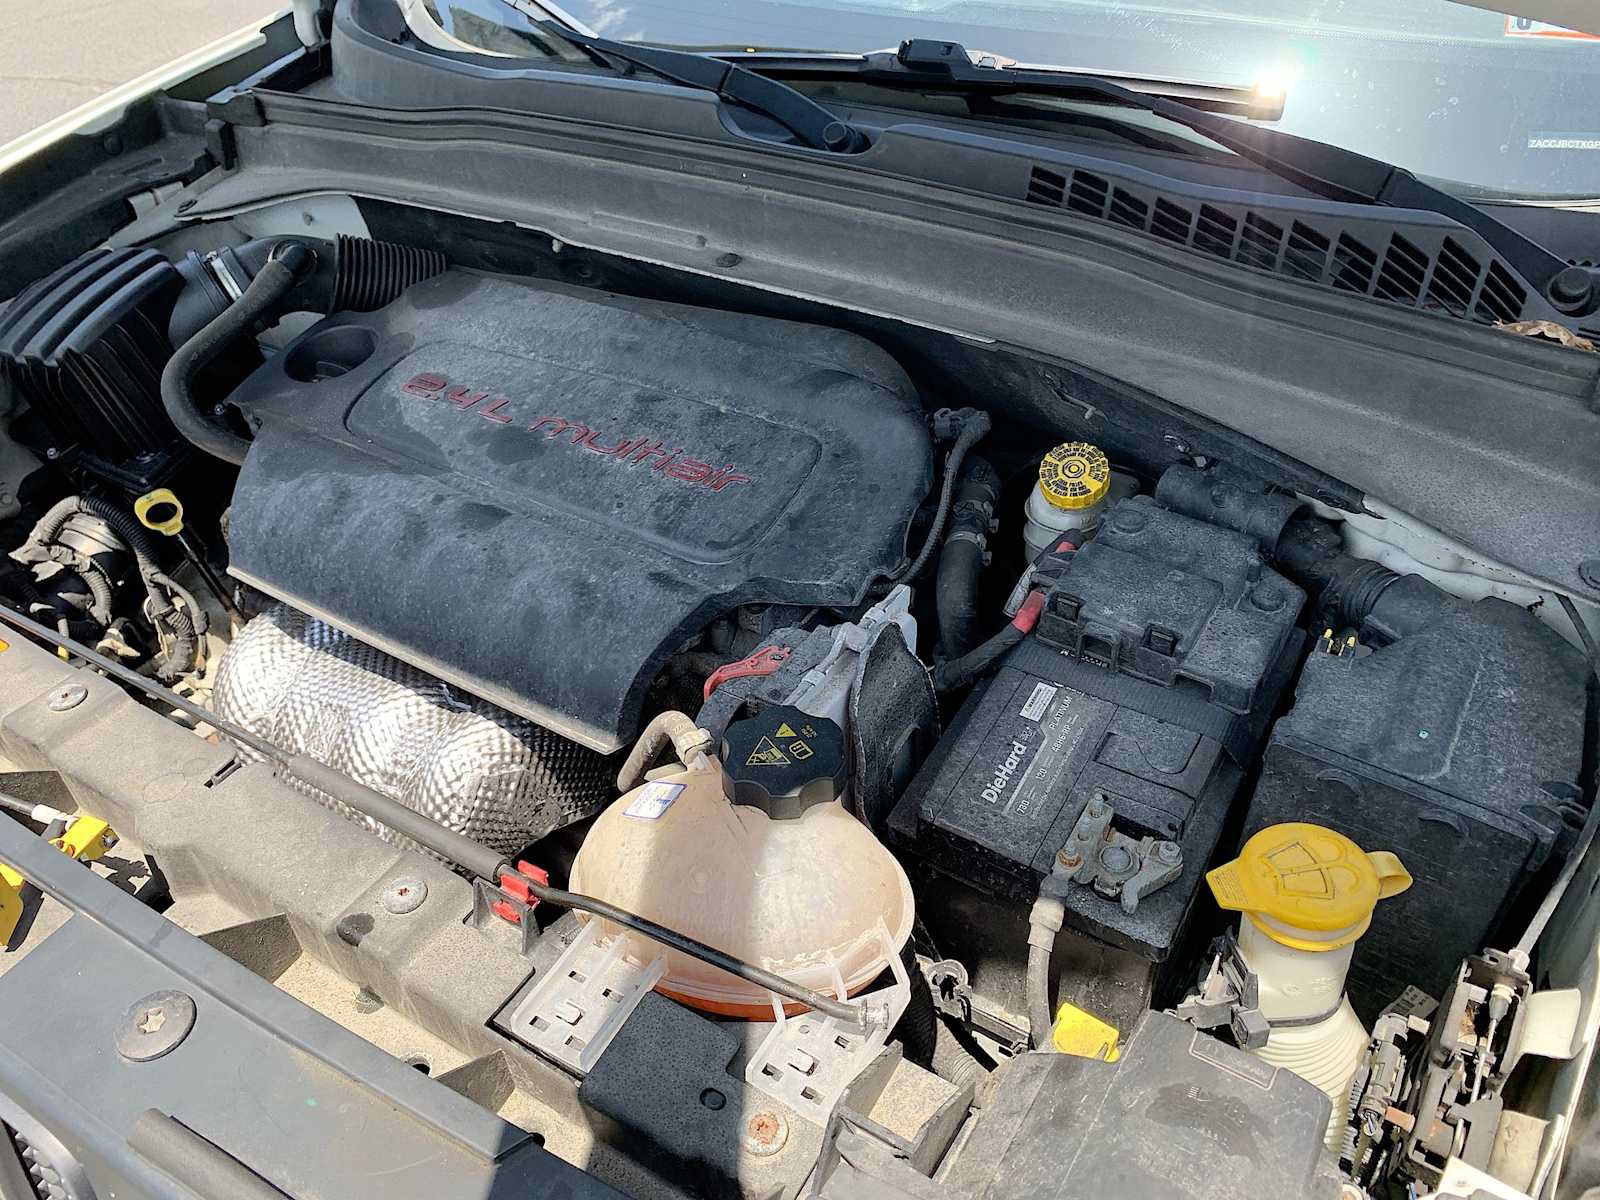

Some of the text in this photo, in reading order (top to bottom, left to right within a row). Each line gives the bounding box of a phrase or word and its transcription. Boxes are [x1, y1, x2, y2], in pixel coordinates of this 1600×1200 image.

[1049, 696, 1073, 730] PLATINUM
[981, 741, 1027, 804] DieHard
[1017, 800, 1030, 814] 730
